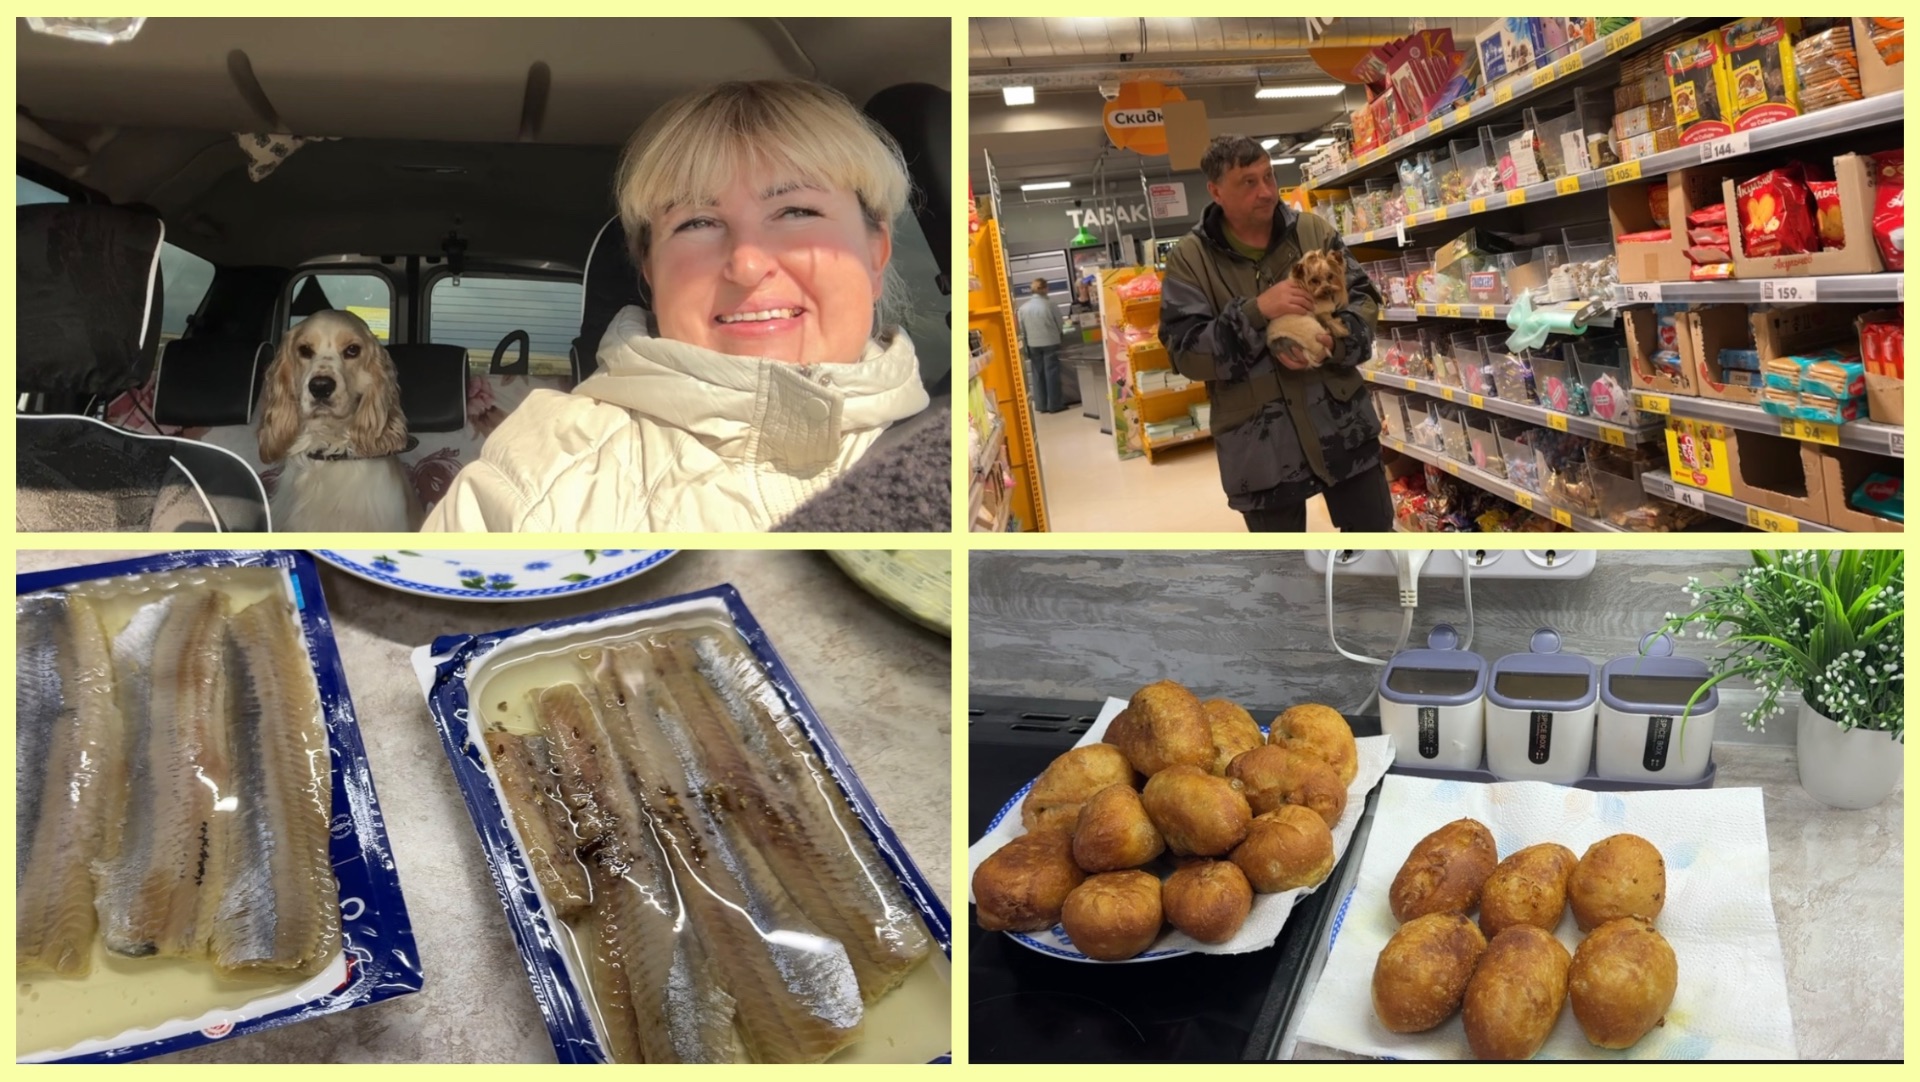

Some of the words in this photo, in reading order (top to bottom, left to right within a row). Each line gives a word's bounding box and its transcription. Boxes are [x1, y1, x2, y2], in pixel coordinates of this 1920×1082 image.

[1714, 143, 1732, 157] 144
[1065, 203, 1148, 229] ТАБАК
[1638, 291, 1648, 301] 99
[1777, 287, 1797, 300] 159
[1803, 426, 1820, 439] 94
[1682, 493, 1692, 505] 41
[1764, 519, 1778, 530] 99
[1657, 718, 1668, 740] SPICE
[1655, 740, 1664, 756] BOX
